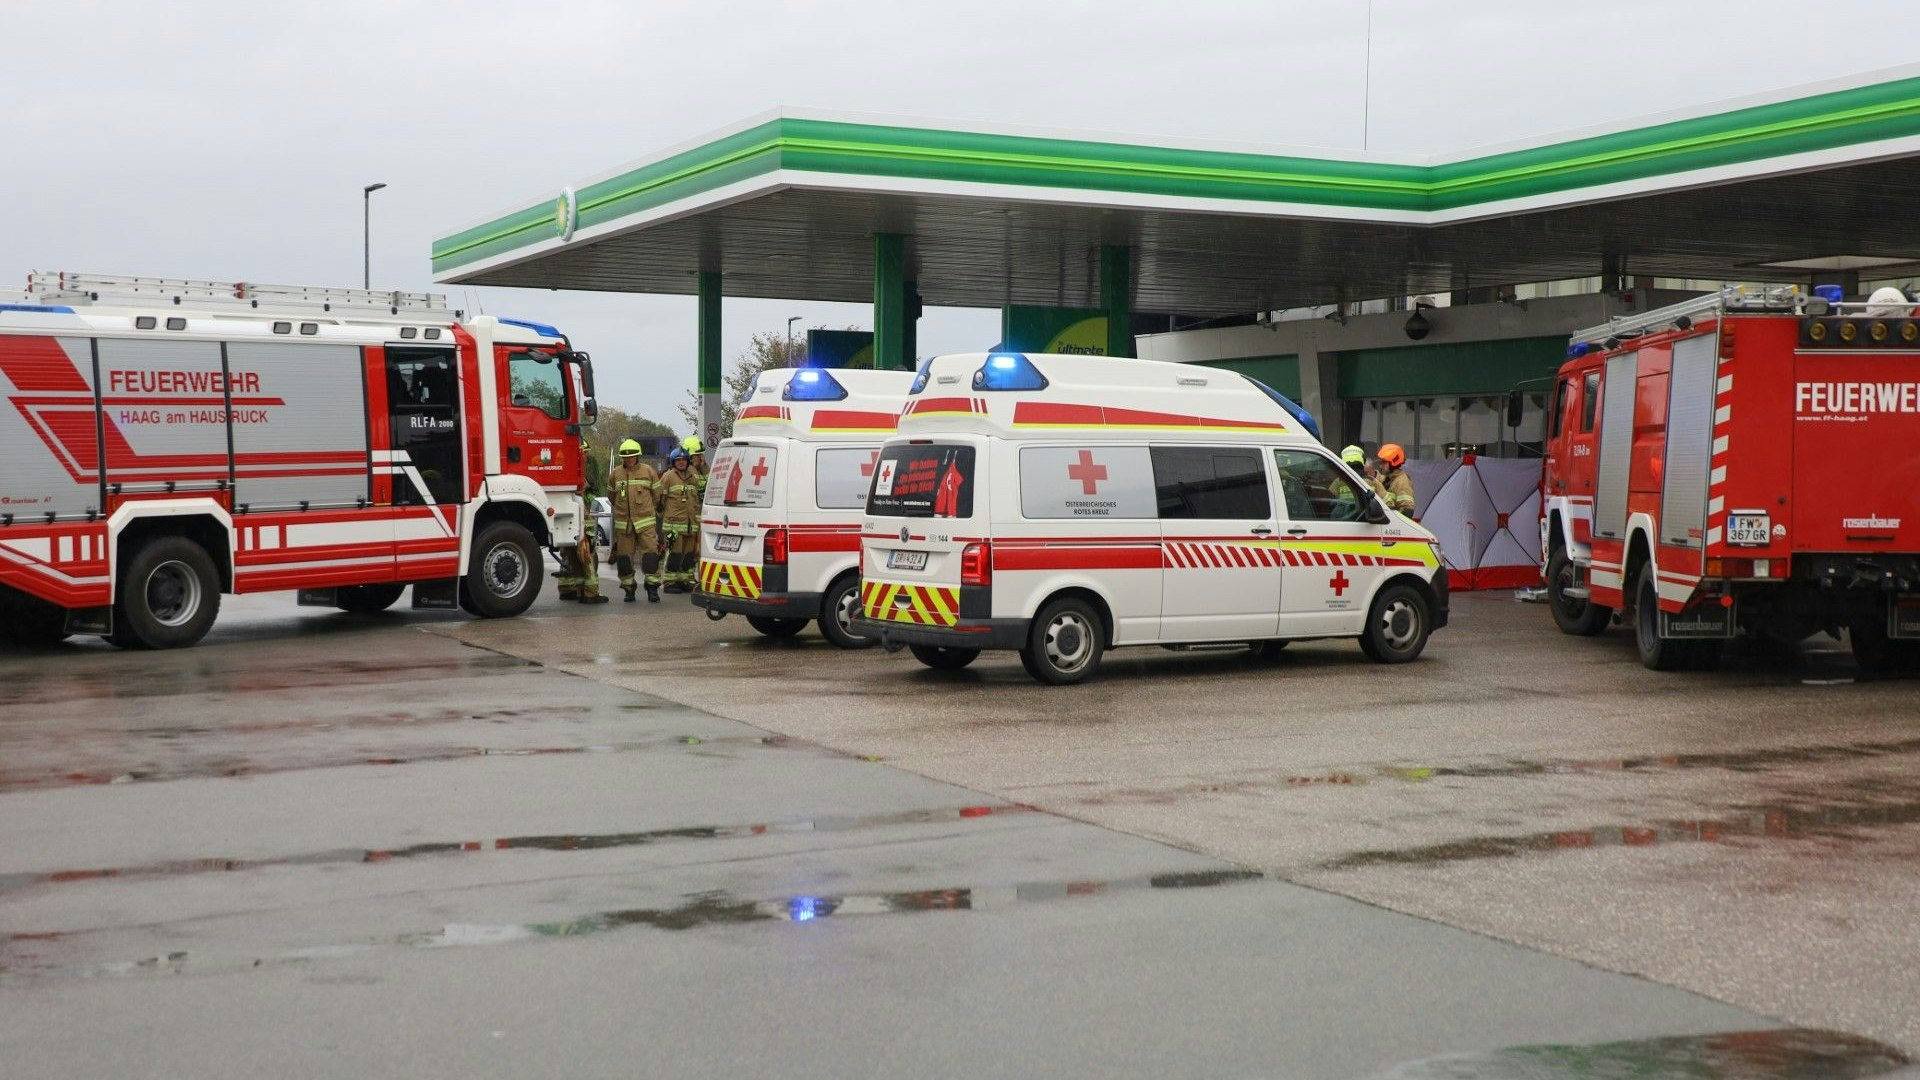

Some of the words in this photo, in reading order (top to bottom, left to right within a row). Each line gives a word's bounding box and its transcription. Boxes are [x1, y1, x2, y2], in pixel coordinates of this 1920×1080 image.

[110, 370, 261, 393] FEUERWEHR
[120, 410, 160, 424] HAAG
[166, 412, 186, 424] am
[190, 410, 269, 424] HAUSRUCK
[410, 416, 436, 428] RLFA
[1739, 518, 1754, 529] FW
[1843, 512, 1901, 529] rosenbauer
[1730, 529, 1750, 541] 367
[1752, 529, 1767, 541] GR
[1670, 614, 1723, 631] rosenbauer
